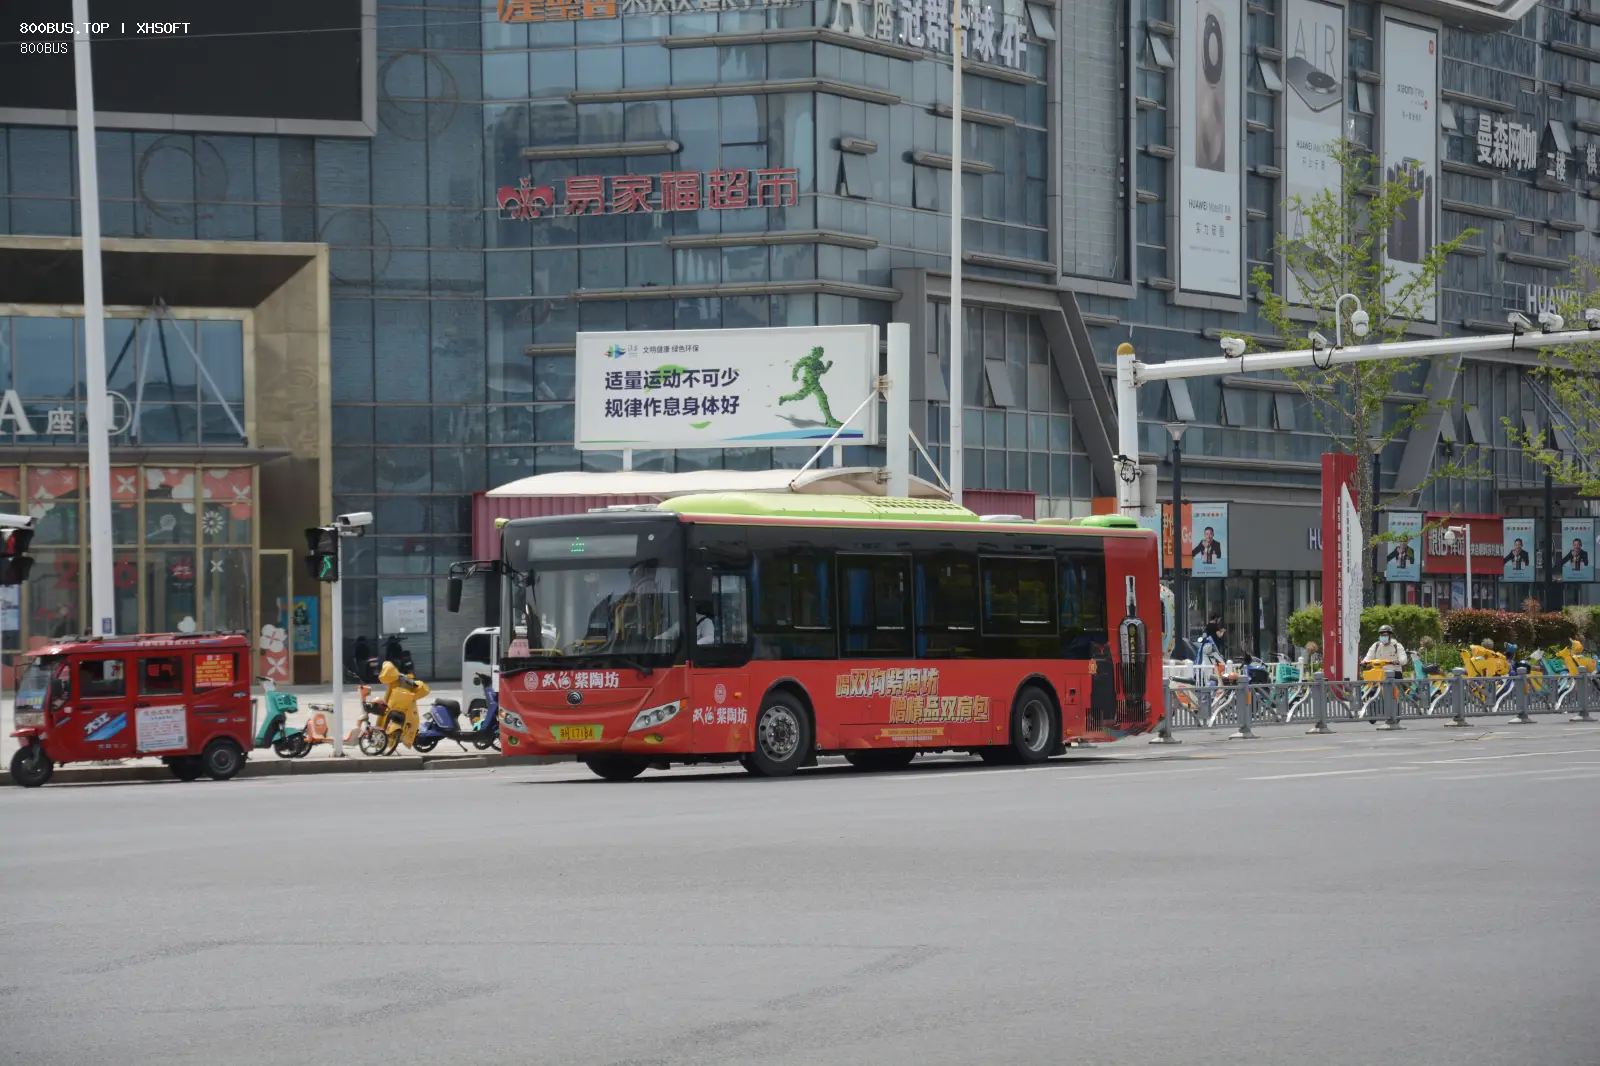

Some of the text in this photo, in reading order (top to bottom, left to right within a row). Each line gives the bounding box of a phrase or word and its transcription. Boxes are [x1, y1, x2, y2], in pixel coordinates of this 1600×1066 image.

[1294, 18, 1336, 78] AIR
[1477, 113, 1537, 171] 曼森网咖
[564, 165, 799, 216] 易家福超市
[1188, 199, 1208, 211] HUAWEI
[642, 345, 670, 354] 文明健康
[671, 344, 700, 353] 绿色环保
[605, 367, 740, 391] 适量运动不可少
[604, 395, 740, 418] 规律作息身体好
[836, 667, 940, 698] 喝双沟紫陶坊
[888, 695, 990, 724] 赠精品双肩包
